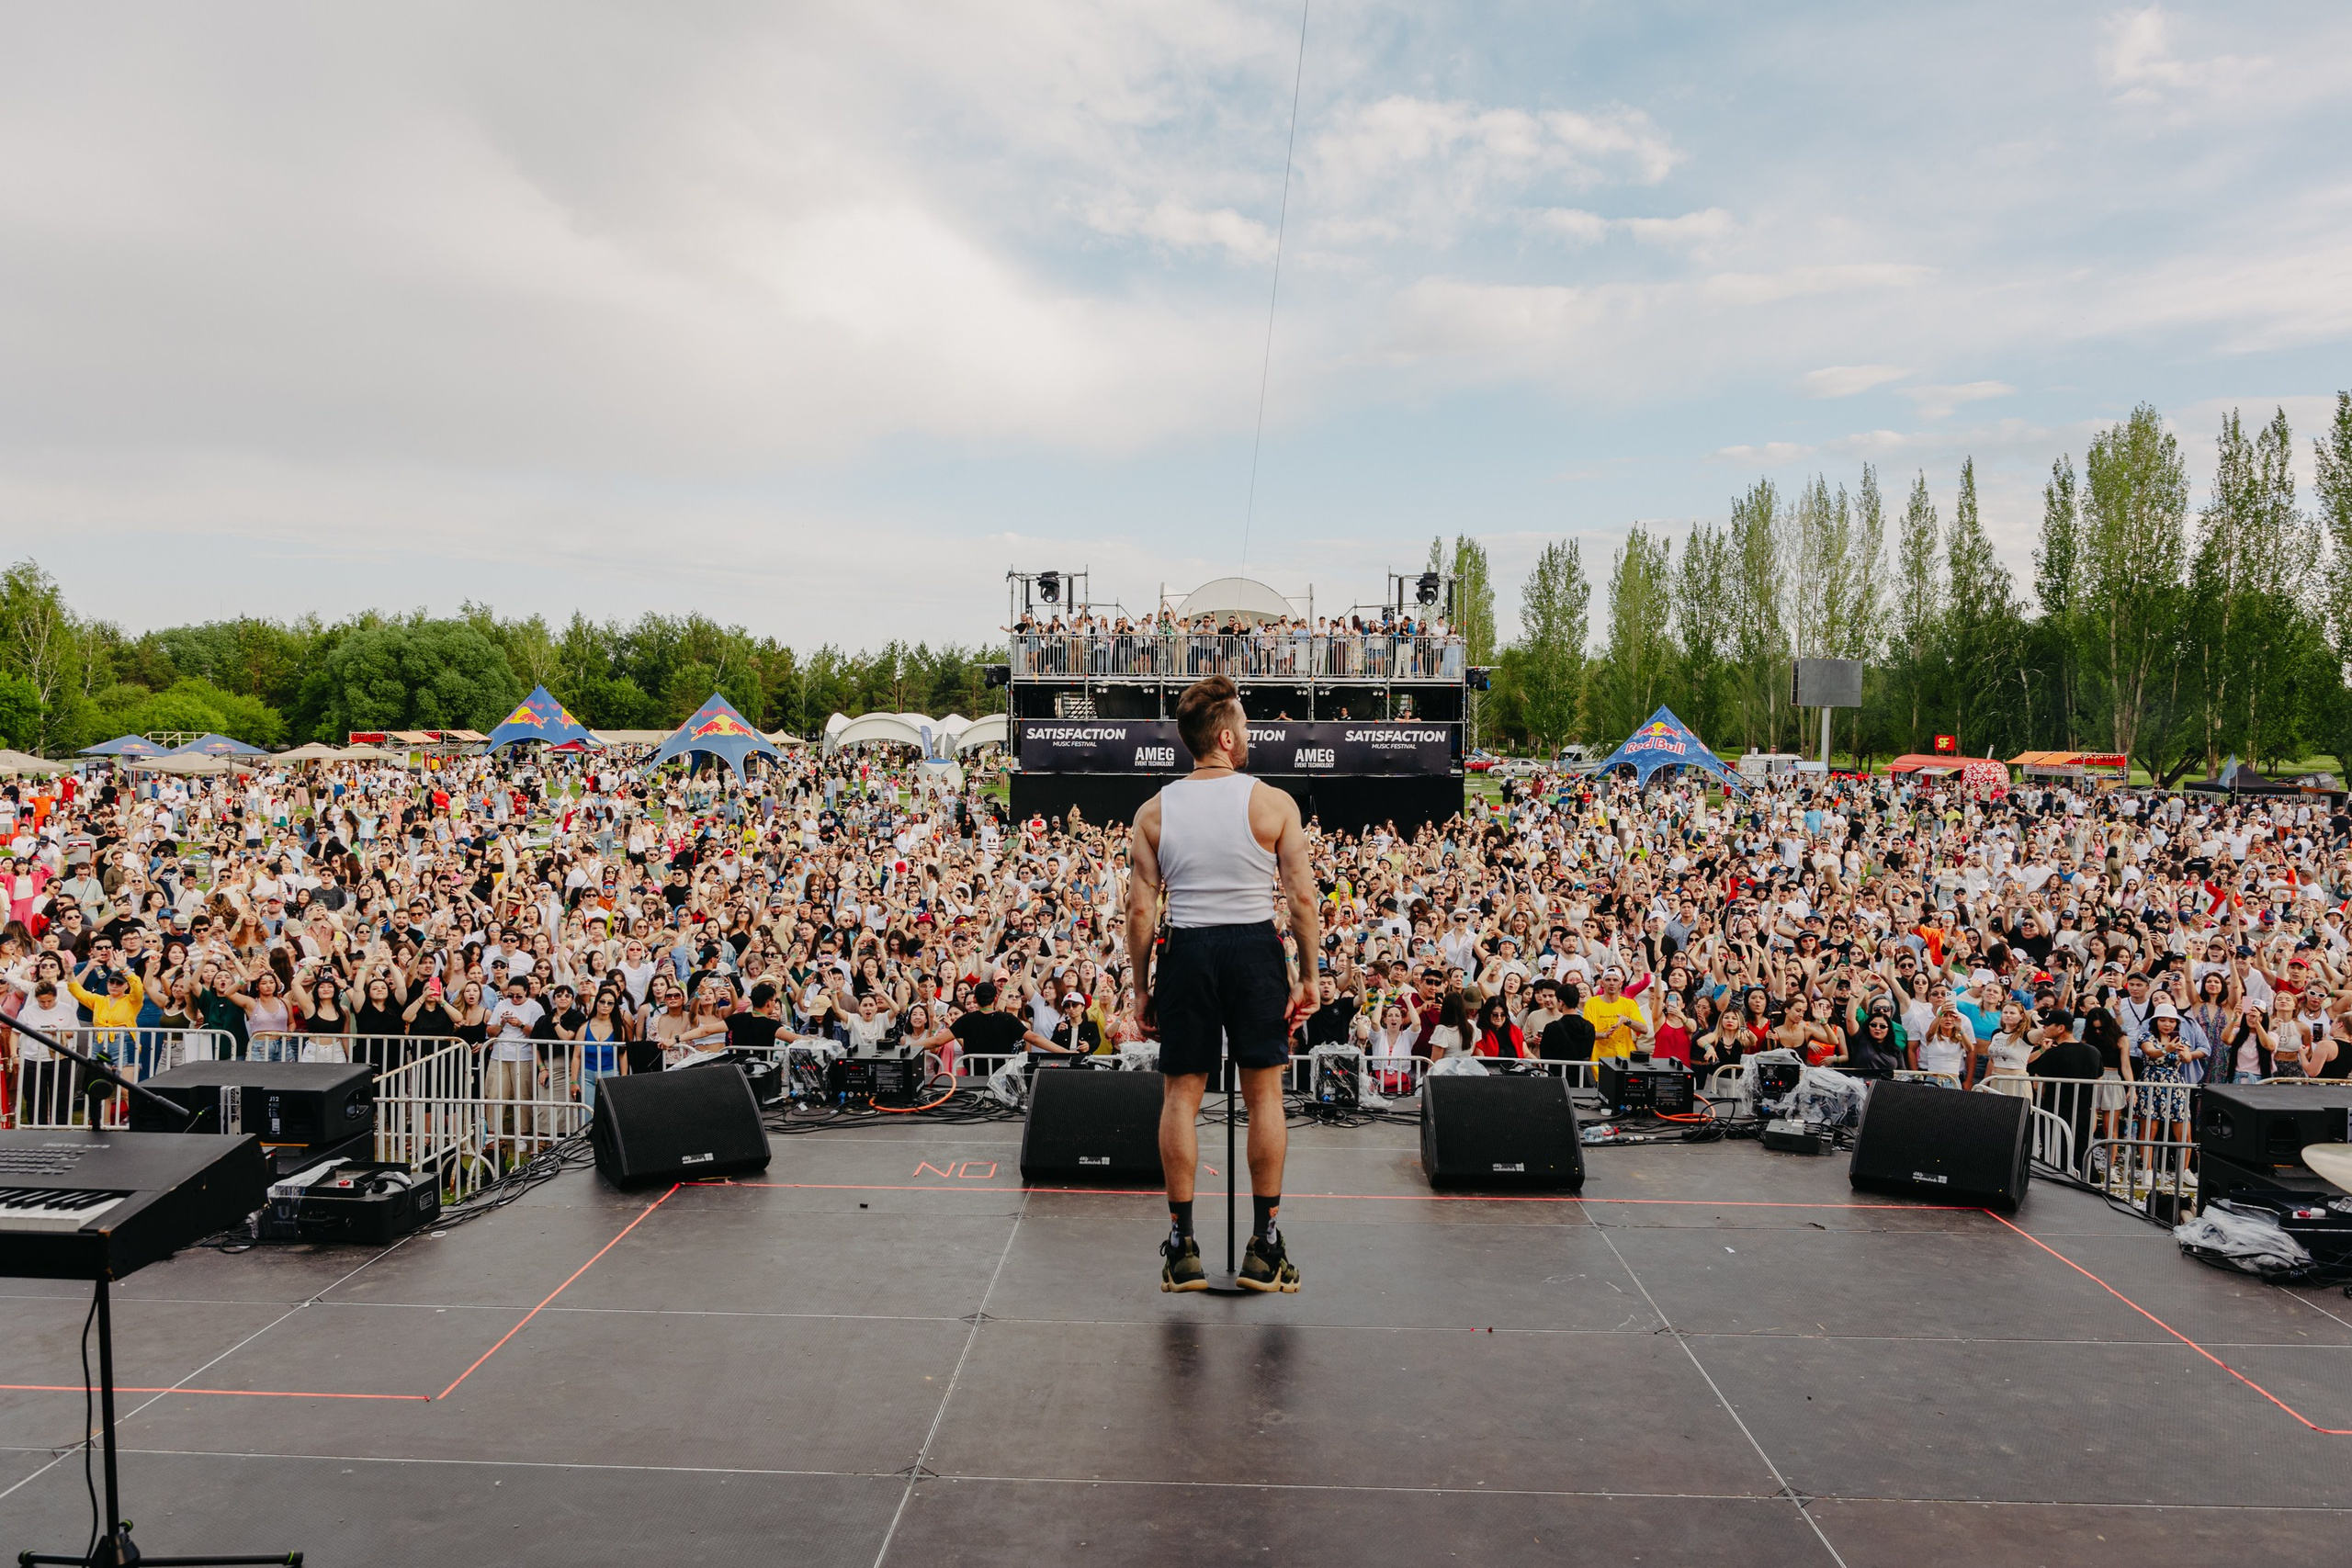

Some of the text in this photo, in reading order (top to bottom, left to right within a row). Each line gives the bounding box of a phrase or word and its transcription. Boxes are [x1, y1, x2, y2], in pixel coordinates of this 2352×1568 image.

[1026, 728, 1126, 740] SATISFACTION
[1345, 730, 1446, 742] SATISFACTION
[1624, 737, 1686, 755] Red Bull
[1938, 738, 1950, 749] SF
[1135, 747, 1175, 761] AMEG
[1295, 749, 1335, 762] AMEG
